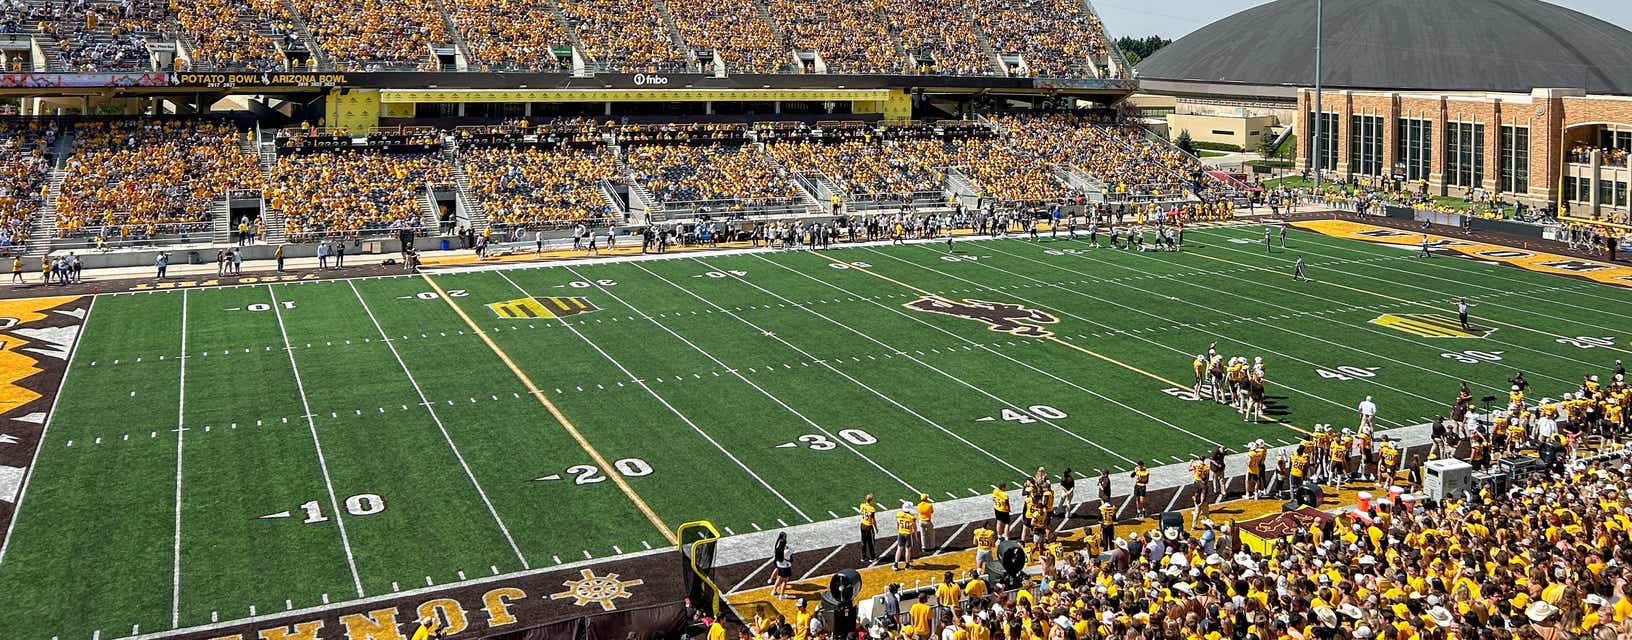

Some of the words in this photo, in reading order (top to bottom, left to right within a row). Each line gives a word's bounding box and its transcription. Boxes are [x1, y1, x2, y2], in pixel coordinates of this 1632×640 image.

[181, 75, 225, 83] POTATO
[229, 75, 260, 83] BOWL
[272, 75, 316, 83] ARIZONA
[319, 75, 347, 83] BOWL
[646, 75, 668, 84] fnbo
[416, 289, 470, 300] 20
[246, 301, 297, 312] 10
[1555, 335, 1615, 349] 20
[1440, 350, 1502, 364] 30
[1315, 365, 1376, 380] 40
[1000, 404, 1069, 424] 40
[798, 428, 878, 451] 30
[566, 457, 655, 486] 20
[300, 493, 387, 524] 10
[899, 519, 910, 530] 50
